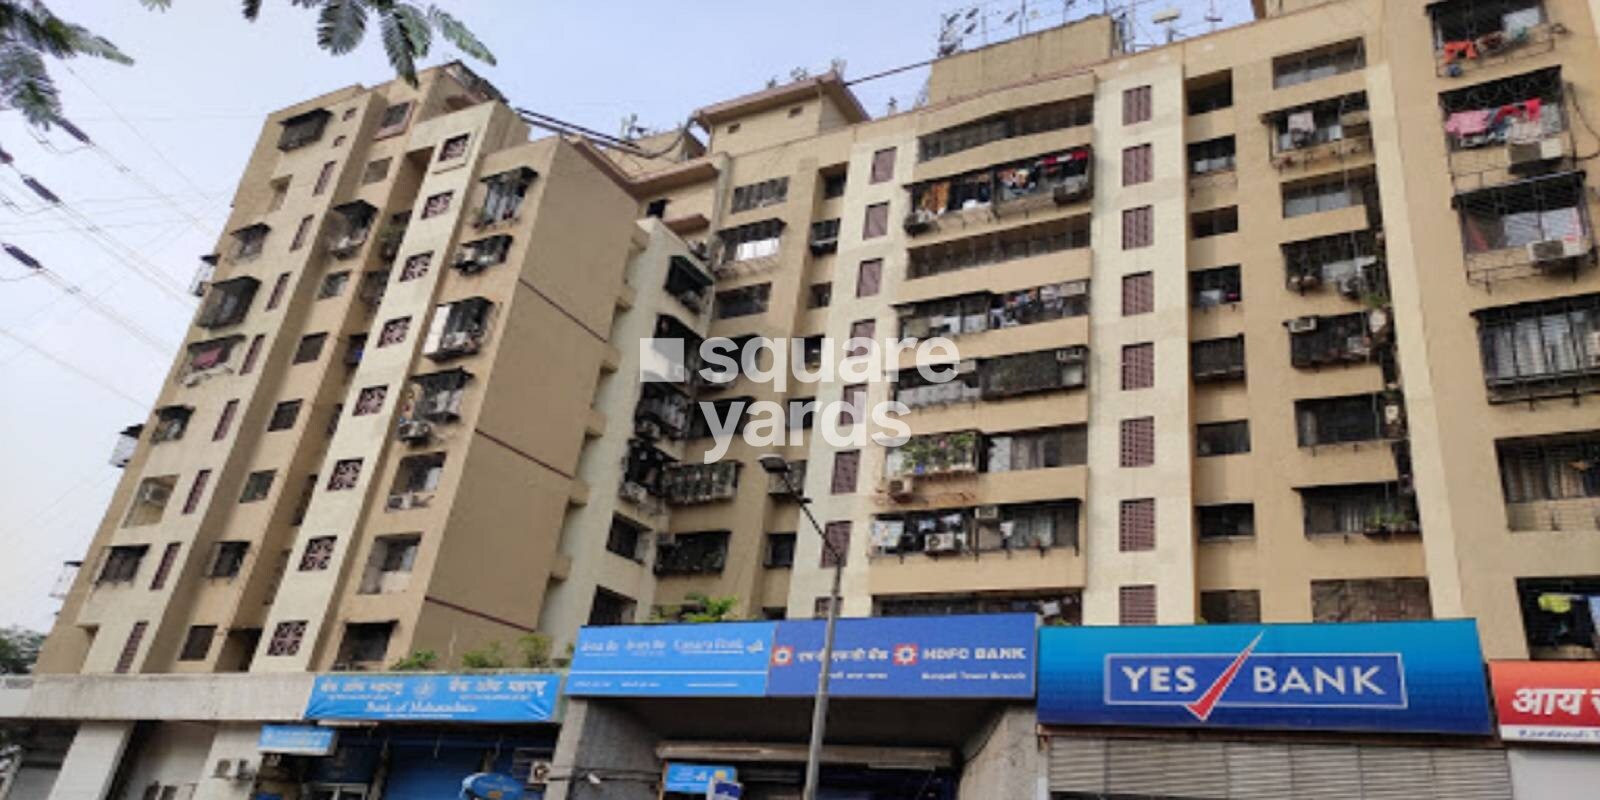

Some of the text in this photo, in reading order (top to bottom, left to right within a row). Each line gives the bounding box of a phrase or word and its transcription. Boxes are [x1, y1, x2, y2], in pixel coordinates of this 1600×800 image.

[923, 647, 1026, 660] HDFC BANK
[1121, 665, 1386, 695] YES BANK
[1512, 687, 1587, 715] आय
